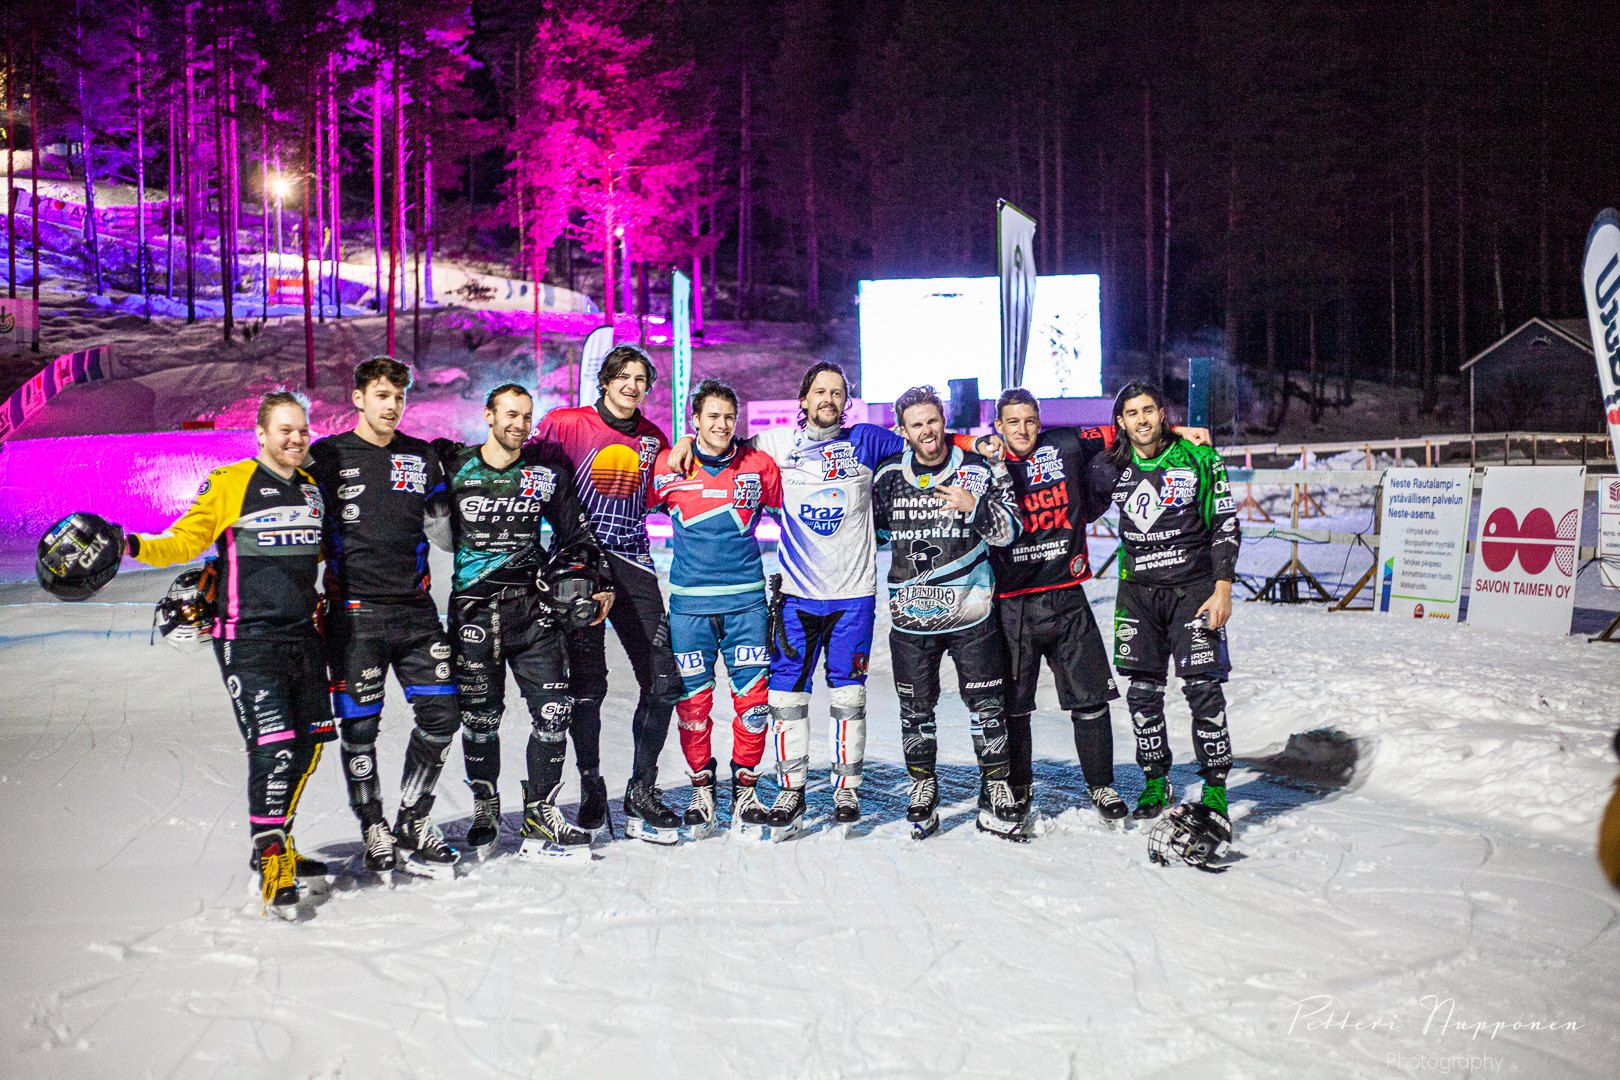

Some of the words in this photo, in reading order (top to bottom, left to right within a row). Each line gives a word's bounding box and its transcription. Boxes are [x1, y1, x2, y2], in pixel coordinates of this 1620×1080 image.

[822, 461, 834, 472] ICE
[835, 457, 858, 470] CROSS
[1027, 465, 1039, 477] ICE
[1040, 459, 1063, 474] CROSS
[391, 470, 404, 481] ICE
[405, 471, 427, 484] CROSS
[520, 480, 533, 489] ICE
[534, 480, 556, 494] CROSS
[964, 480, 989, 495] CROSS
[1160, 486, 1173, 498] ICE
[1390, 478, 1411, 488] Neste
[1413, 478, 1454, 492] Rautalampi
[734, 489, 745, 500] ICE
[1024, 480, 1069, 512] UGH
[1389, 493, 1430, 505] ystävällisen
[1432, 494, 1463, 507] palvelun
[800, 504, 844, 518] Praz
[813, 520, 838, 532] Arly
[1024, 506, 1073, 533] UCK
[1475, 579, 1510, 593] SAVON
[1513, 582, 1552, 597] TAIMEN
[1556, 585, 1571, 598] OY
[676, 652, 703, 669] VB
[1191, 651, 1214, 660] IRON
[1191, 658, 1214, 666] NECK
[965, 678, 1003, 689] BAUER
[1138, 736, 1161, 750] BD
